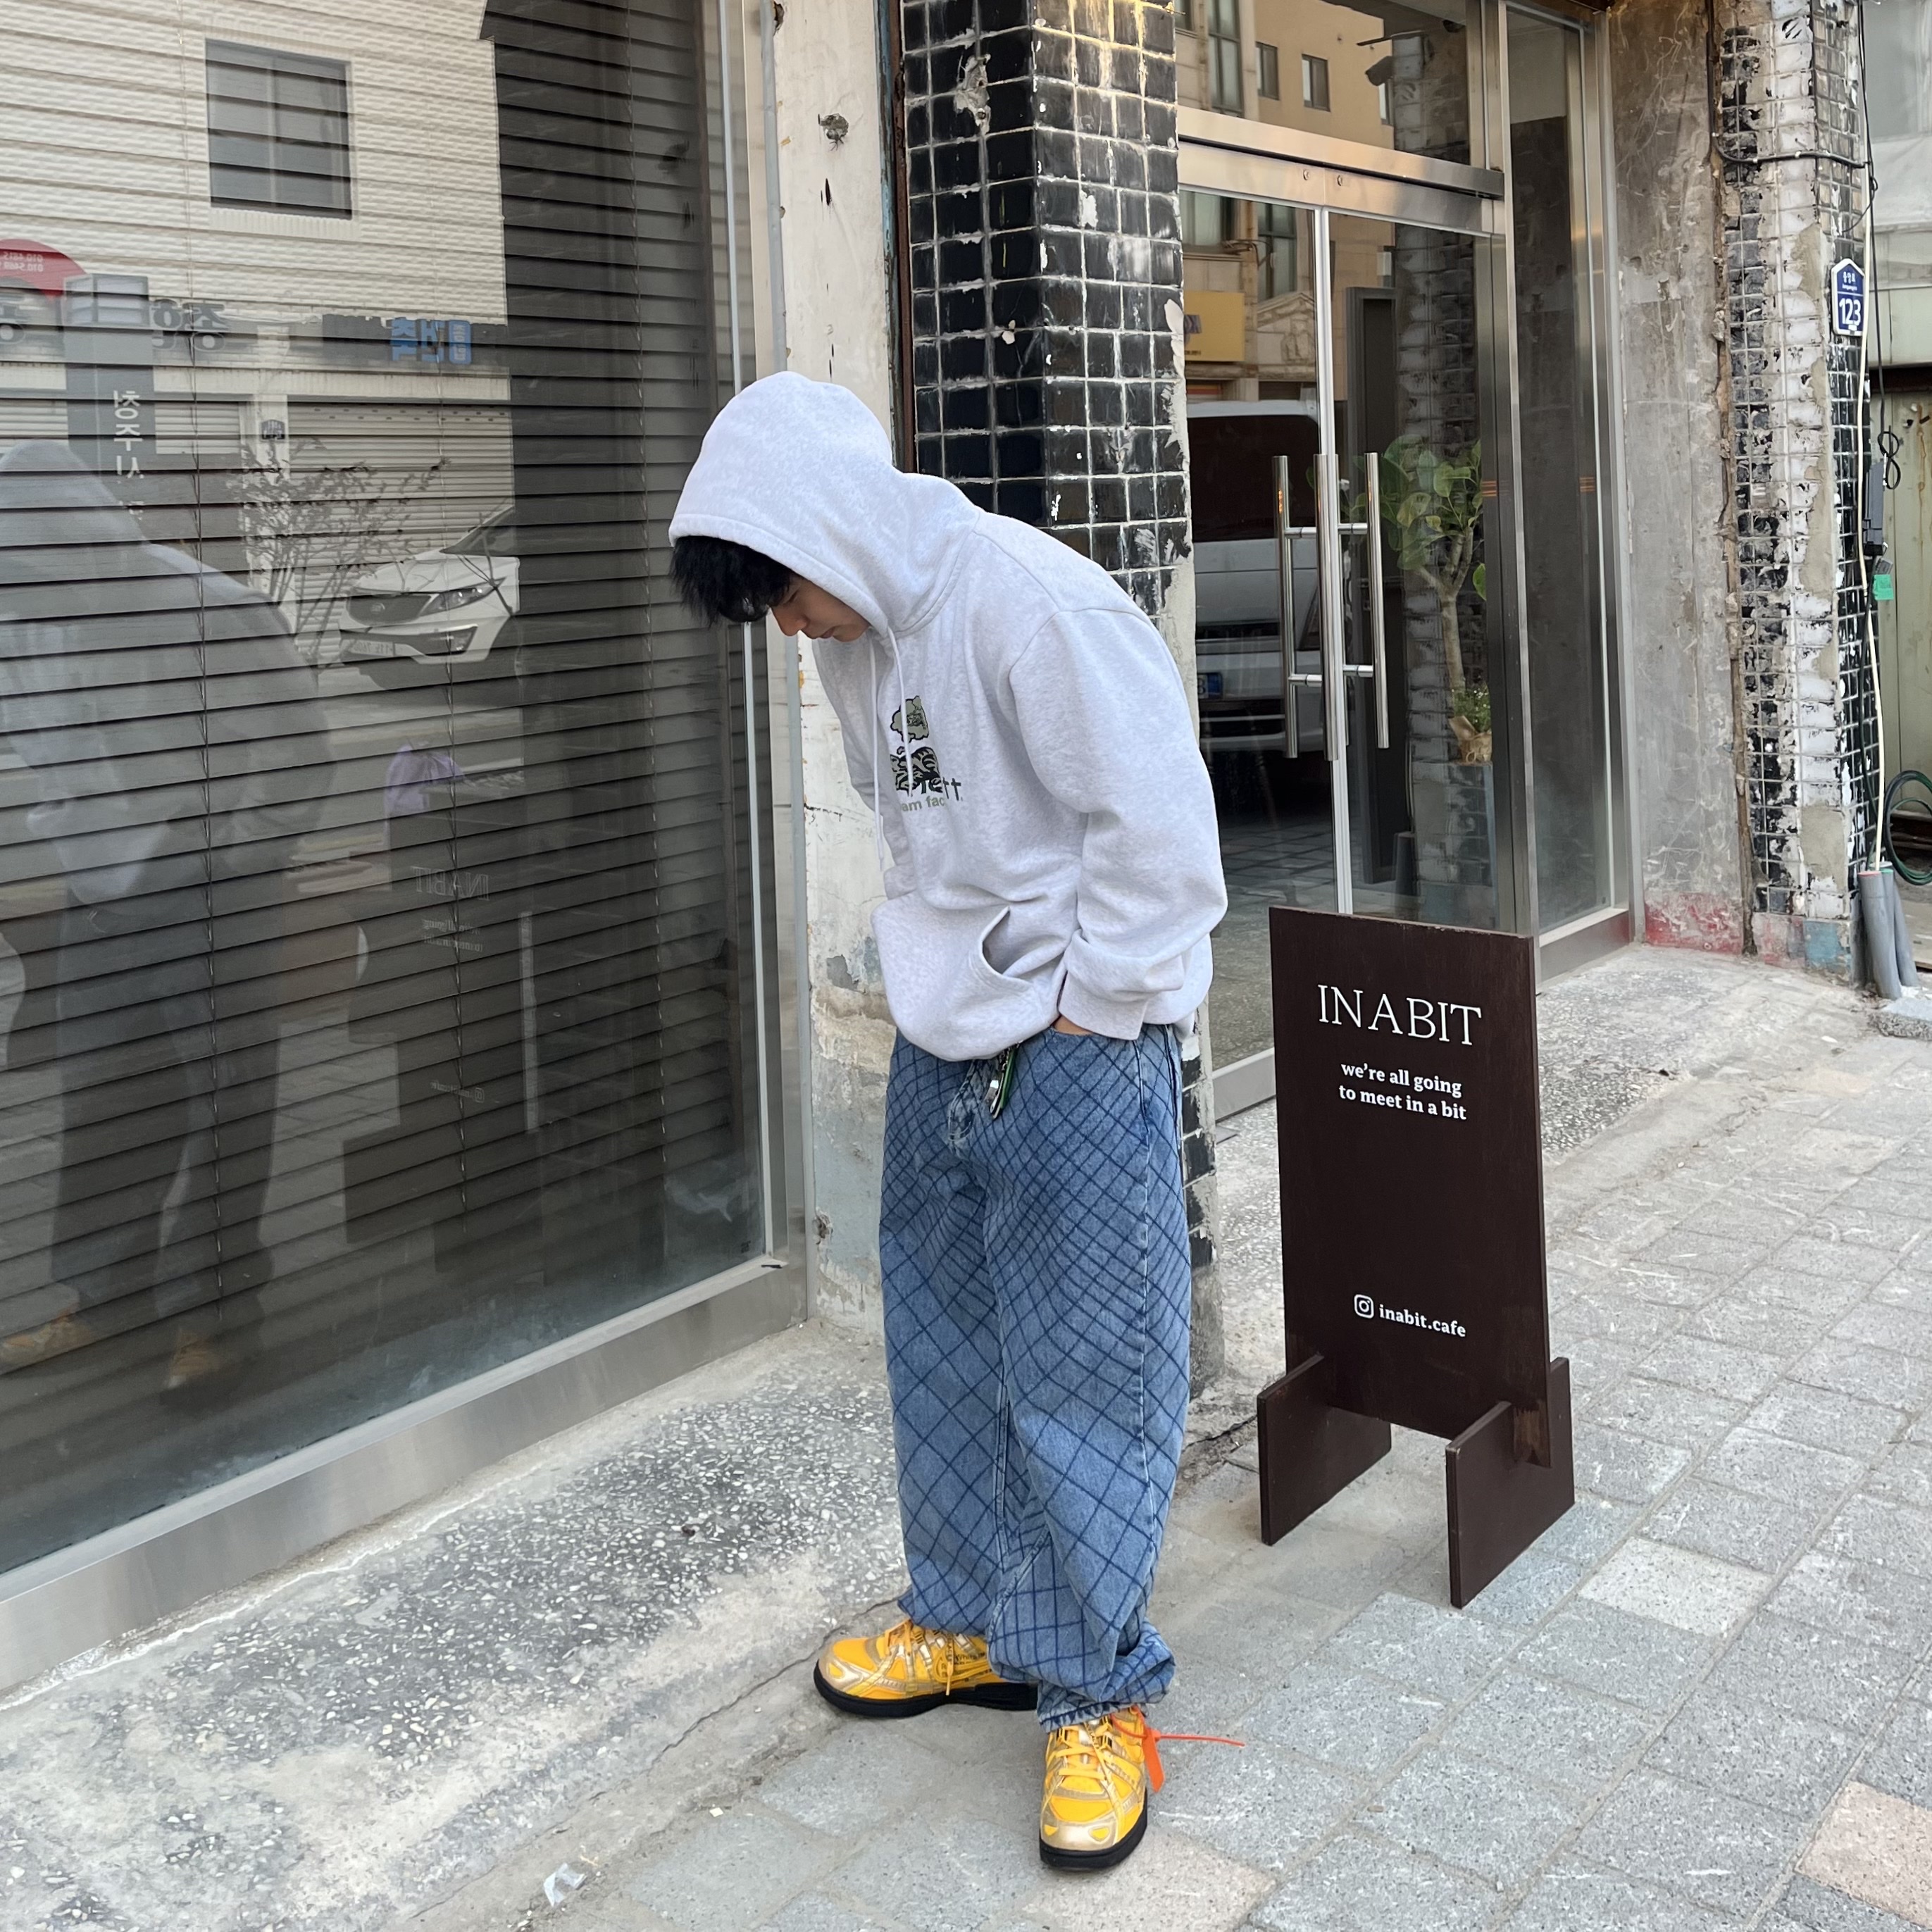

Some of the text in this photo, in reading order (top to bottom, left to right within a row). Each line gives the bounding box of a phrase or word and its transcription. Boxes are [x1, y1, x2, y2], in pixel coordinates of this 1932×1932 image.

[1839, 297, 1862, 326] 123
[1341, 1063, 1462, 1098] we're all going
[1339, 1085, 1467, 1120] to meet in a bit
[1379, 1304, 1466, 1337] inabit.cafe
